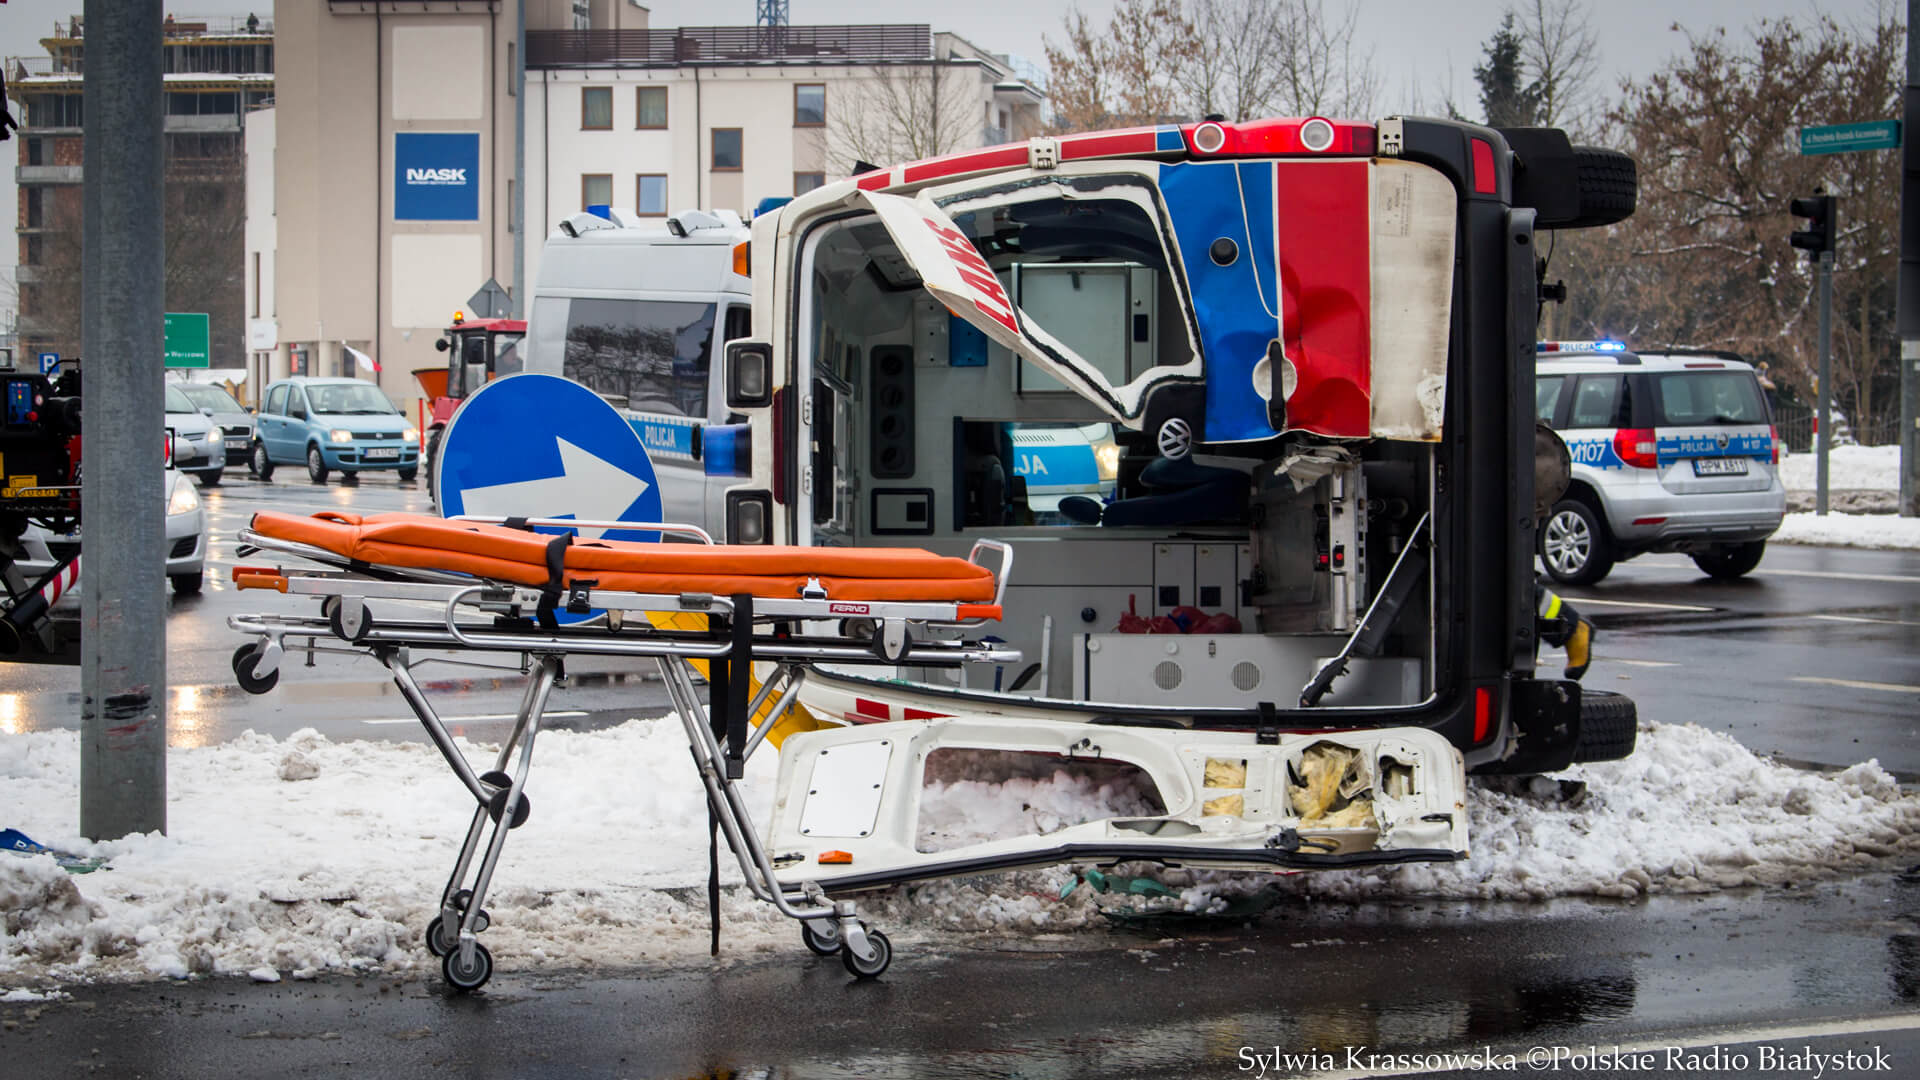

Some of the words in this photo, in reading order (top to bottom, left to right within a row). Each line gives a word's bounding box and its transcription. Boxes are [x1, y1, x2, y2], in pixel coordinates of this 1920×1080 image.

[406, 168, 467, 181] NASK
[1560, 343, 1595, 353] POLICJA
[43, 355, 56, 372] P
[645, 425, 677, 449] POLICJA
[1680, 441, 1715, 453] POLICJA
[1014, 454, 1048, 475] JA
[832, 604, 868, 613] FERNO
